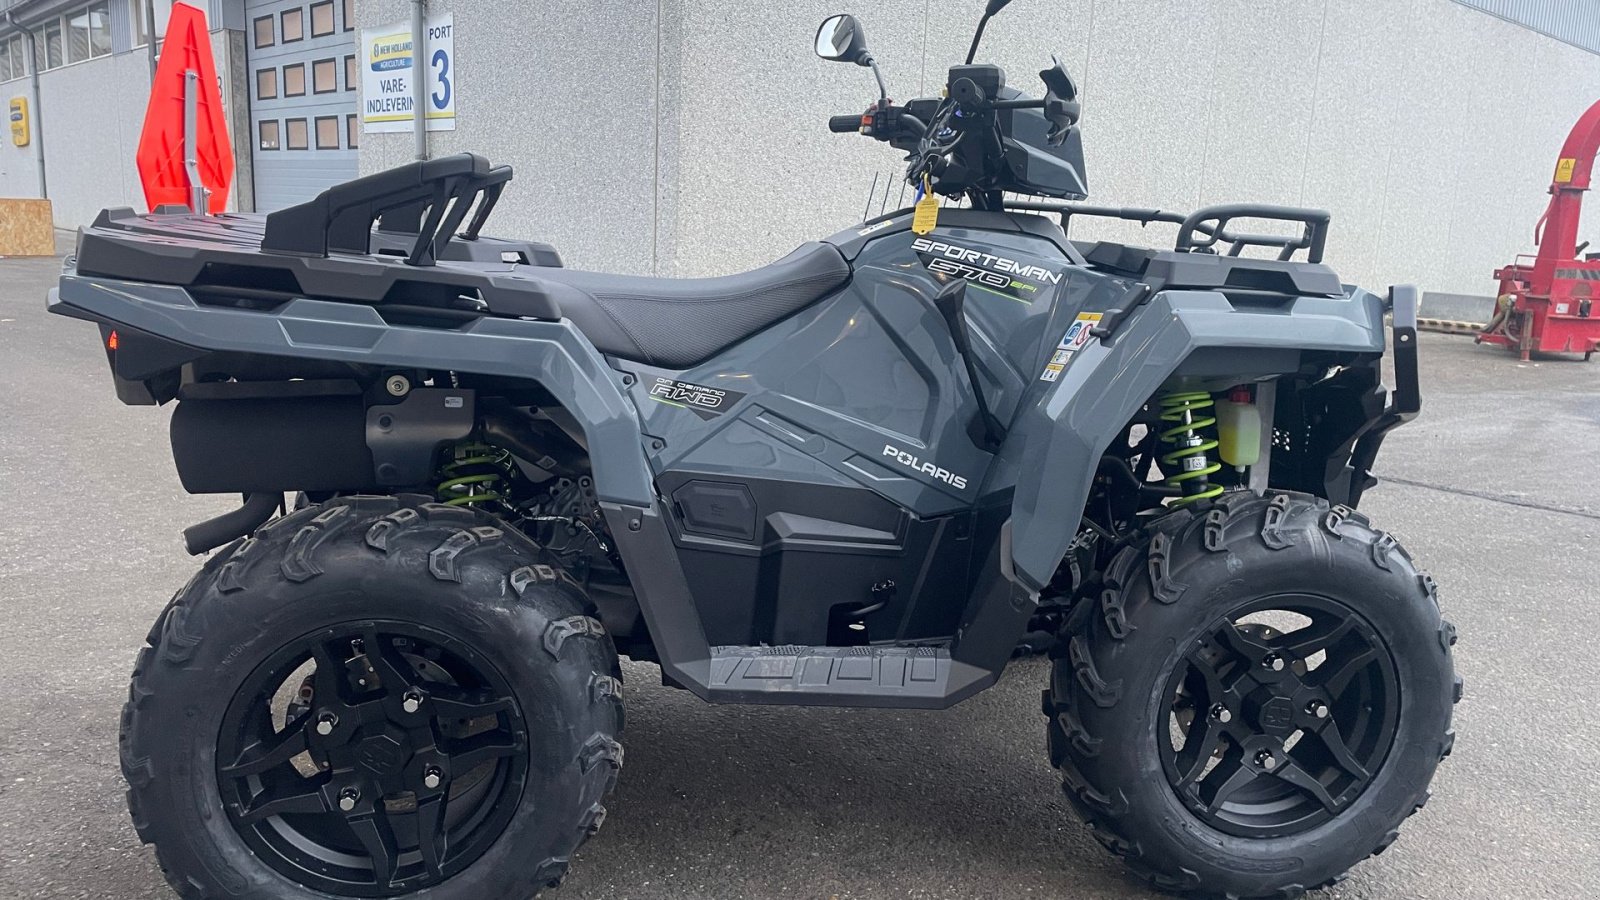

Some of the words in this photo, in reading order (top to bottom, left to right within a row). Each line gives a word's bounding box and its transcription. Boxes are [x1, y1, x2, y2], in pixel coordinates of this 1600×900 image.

[429, 25, 452, 40] PORT
[380, 78, 406, 93] VARE-
[431, 49, 451, 110] 3
[367, 95, 414, 113] INDLEVERIN
[911, 238, 1063, 285] SPORTSMAN
[927, 257, 1011, 288] 570
[649, 383, 723, 408] AWD
[656, 377, 673, 386] ON
[677, 382, 726, 396] DEMAND
[882, 444, 968, 490] POLARIS
